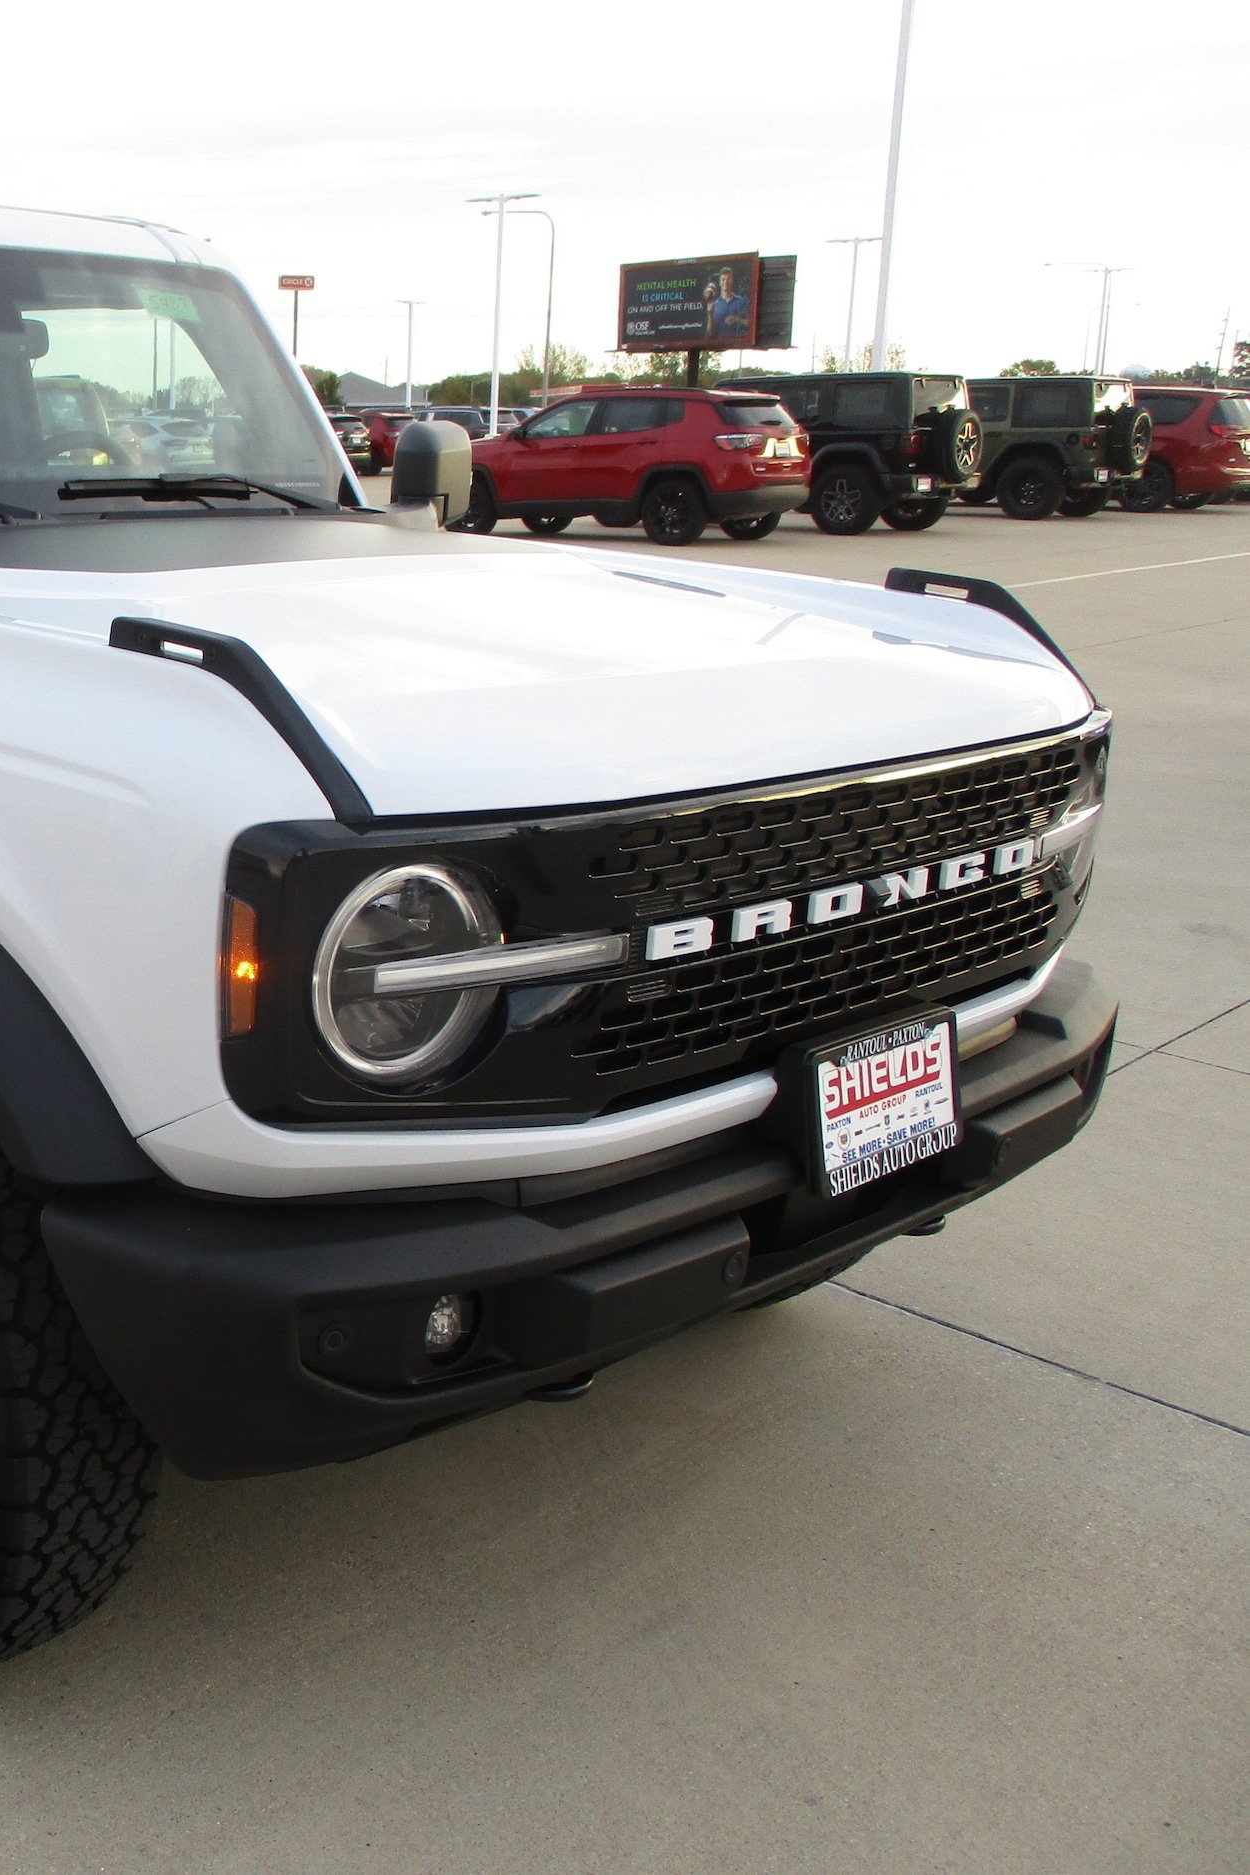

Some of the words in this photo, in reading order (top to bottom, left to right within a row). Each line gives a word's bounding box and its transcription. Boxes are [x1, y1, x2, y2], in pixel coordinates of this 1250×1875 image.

[636, 281, 665, 291] MENTAL
[667, 279, 696, 289] HEALTH
[641, 293, 649, 302] IS
[650, 292, 684, 302] CRITICAL
[639, 305, 653, 313] AND
[655, 304, 668, 312] OFF
[635, 321, 649, 331] OSF
[645, 837, 1034, 961] BRONCO
[846, 1034, 887, 1061] RANTOUL
[892, 1021, 926, 1047] PAXTON
[823, 1032, 943, 1112] SHIELDS
[914, 1082, 943, 1099] RANTOUL
[859, 1105, 879, 1120] AUTO
[881, 1094, 907, 1112] GROUP
[826, 1116, 852, 1133] PAXTON
[841, 1149, 857, 1163] SEE
[910, 1116, 936, 1133] MORE!
[830, 1154, 880, 1197] SHIELDS
[882, 1139, 916, 1176] AUTO
[916, 1122, 958, 1161] GROUP
